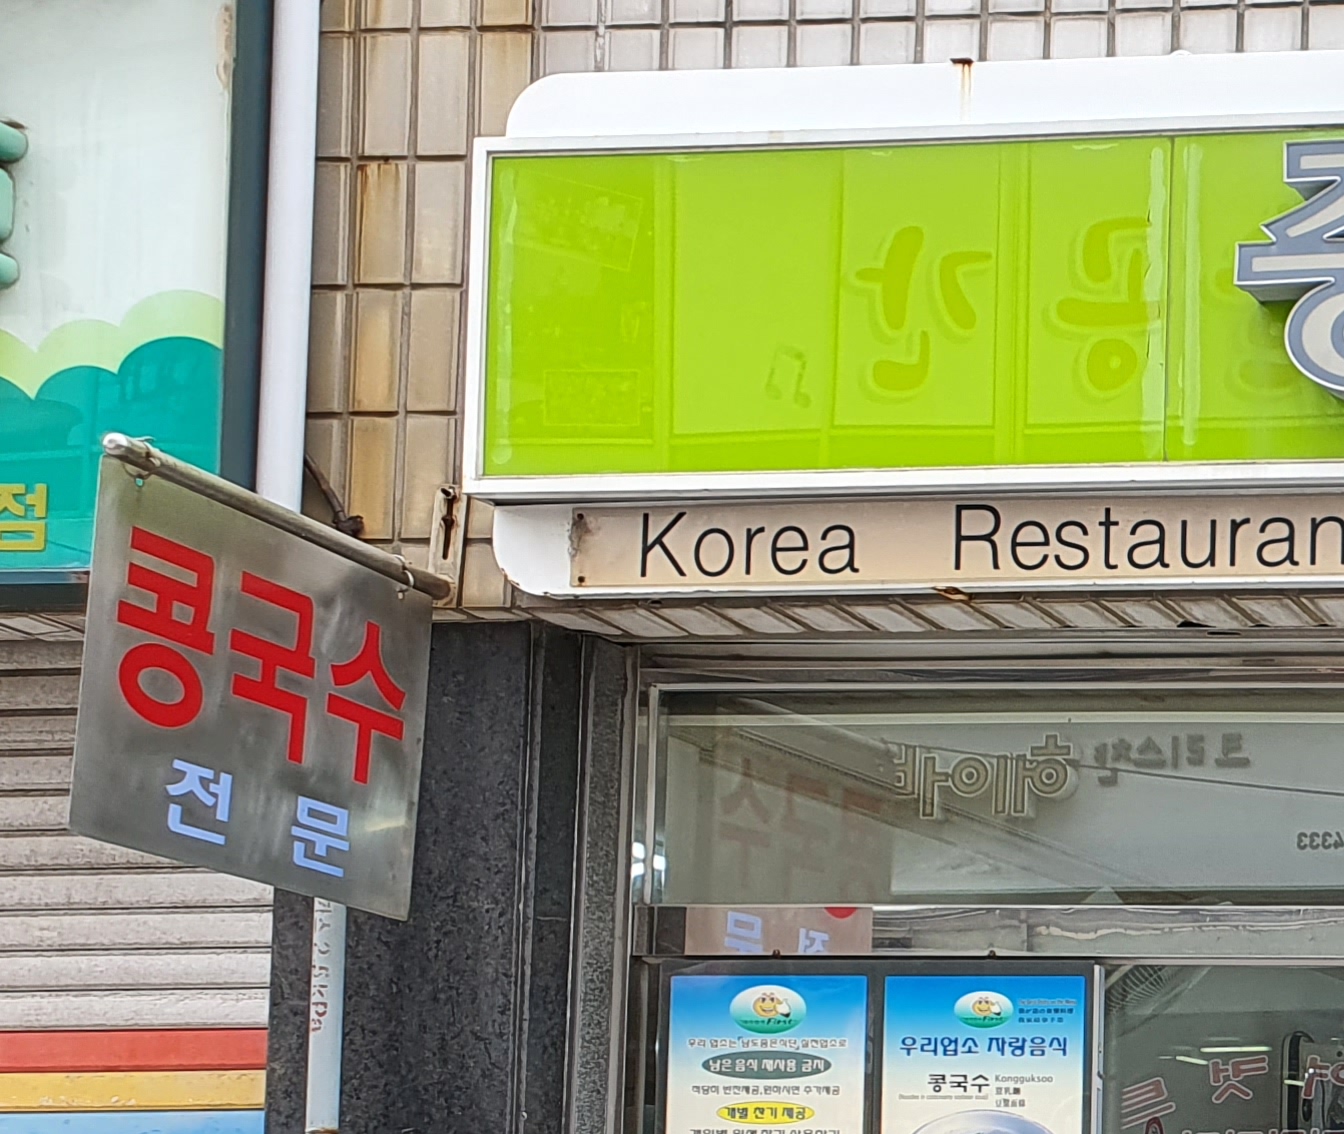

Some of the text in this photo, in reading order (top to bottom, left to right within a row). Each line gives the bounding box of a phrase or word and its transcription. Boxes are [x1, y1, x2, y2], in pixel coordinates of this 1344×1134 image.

[639, 511, 860, 578] Korea
[116, 526, 407, 785] 콩국수
[166, 758, 351, 878] 전문
[900, 1036, 1068, 1057] 우리업소 자랑음식
[735, 1058, 758, 1072] 음식
[761, 1058, 797, 1072] 재사용
[801, 1058, 825, 1072] 금지
[927, 1074, 990, 1093] 콩국수
[781, 1106, 807, 1120] 제공
